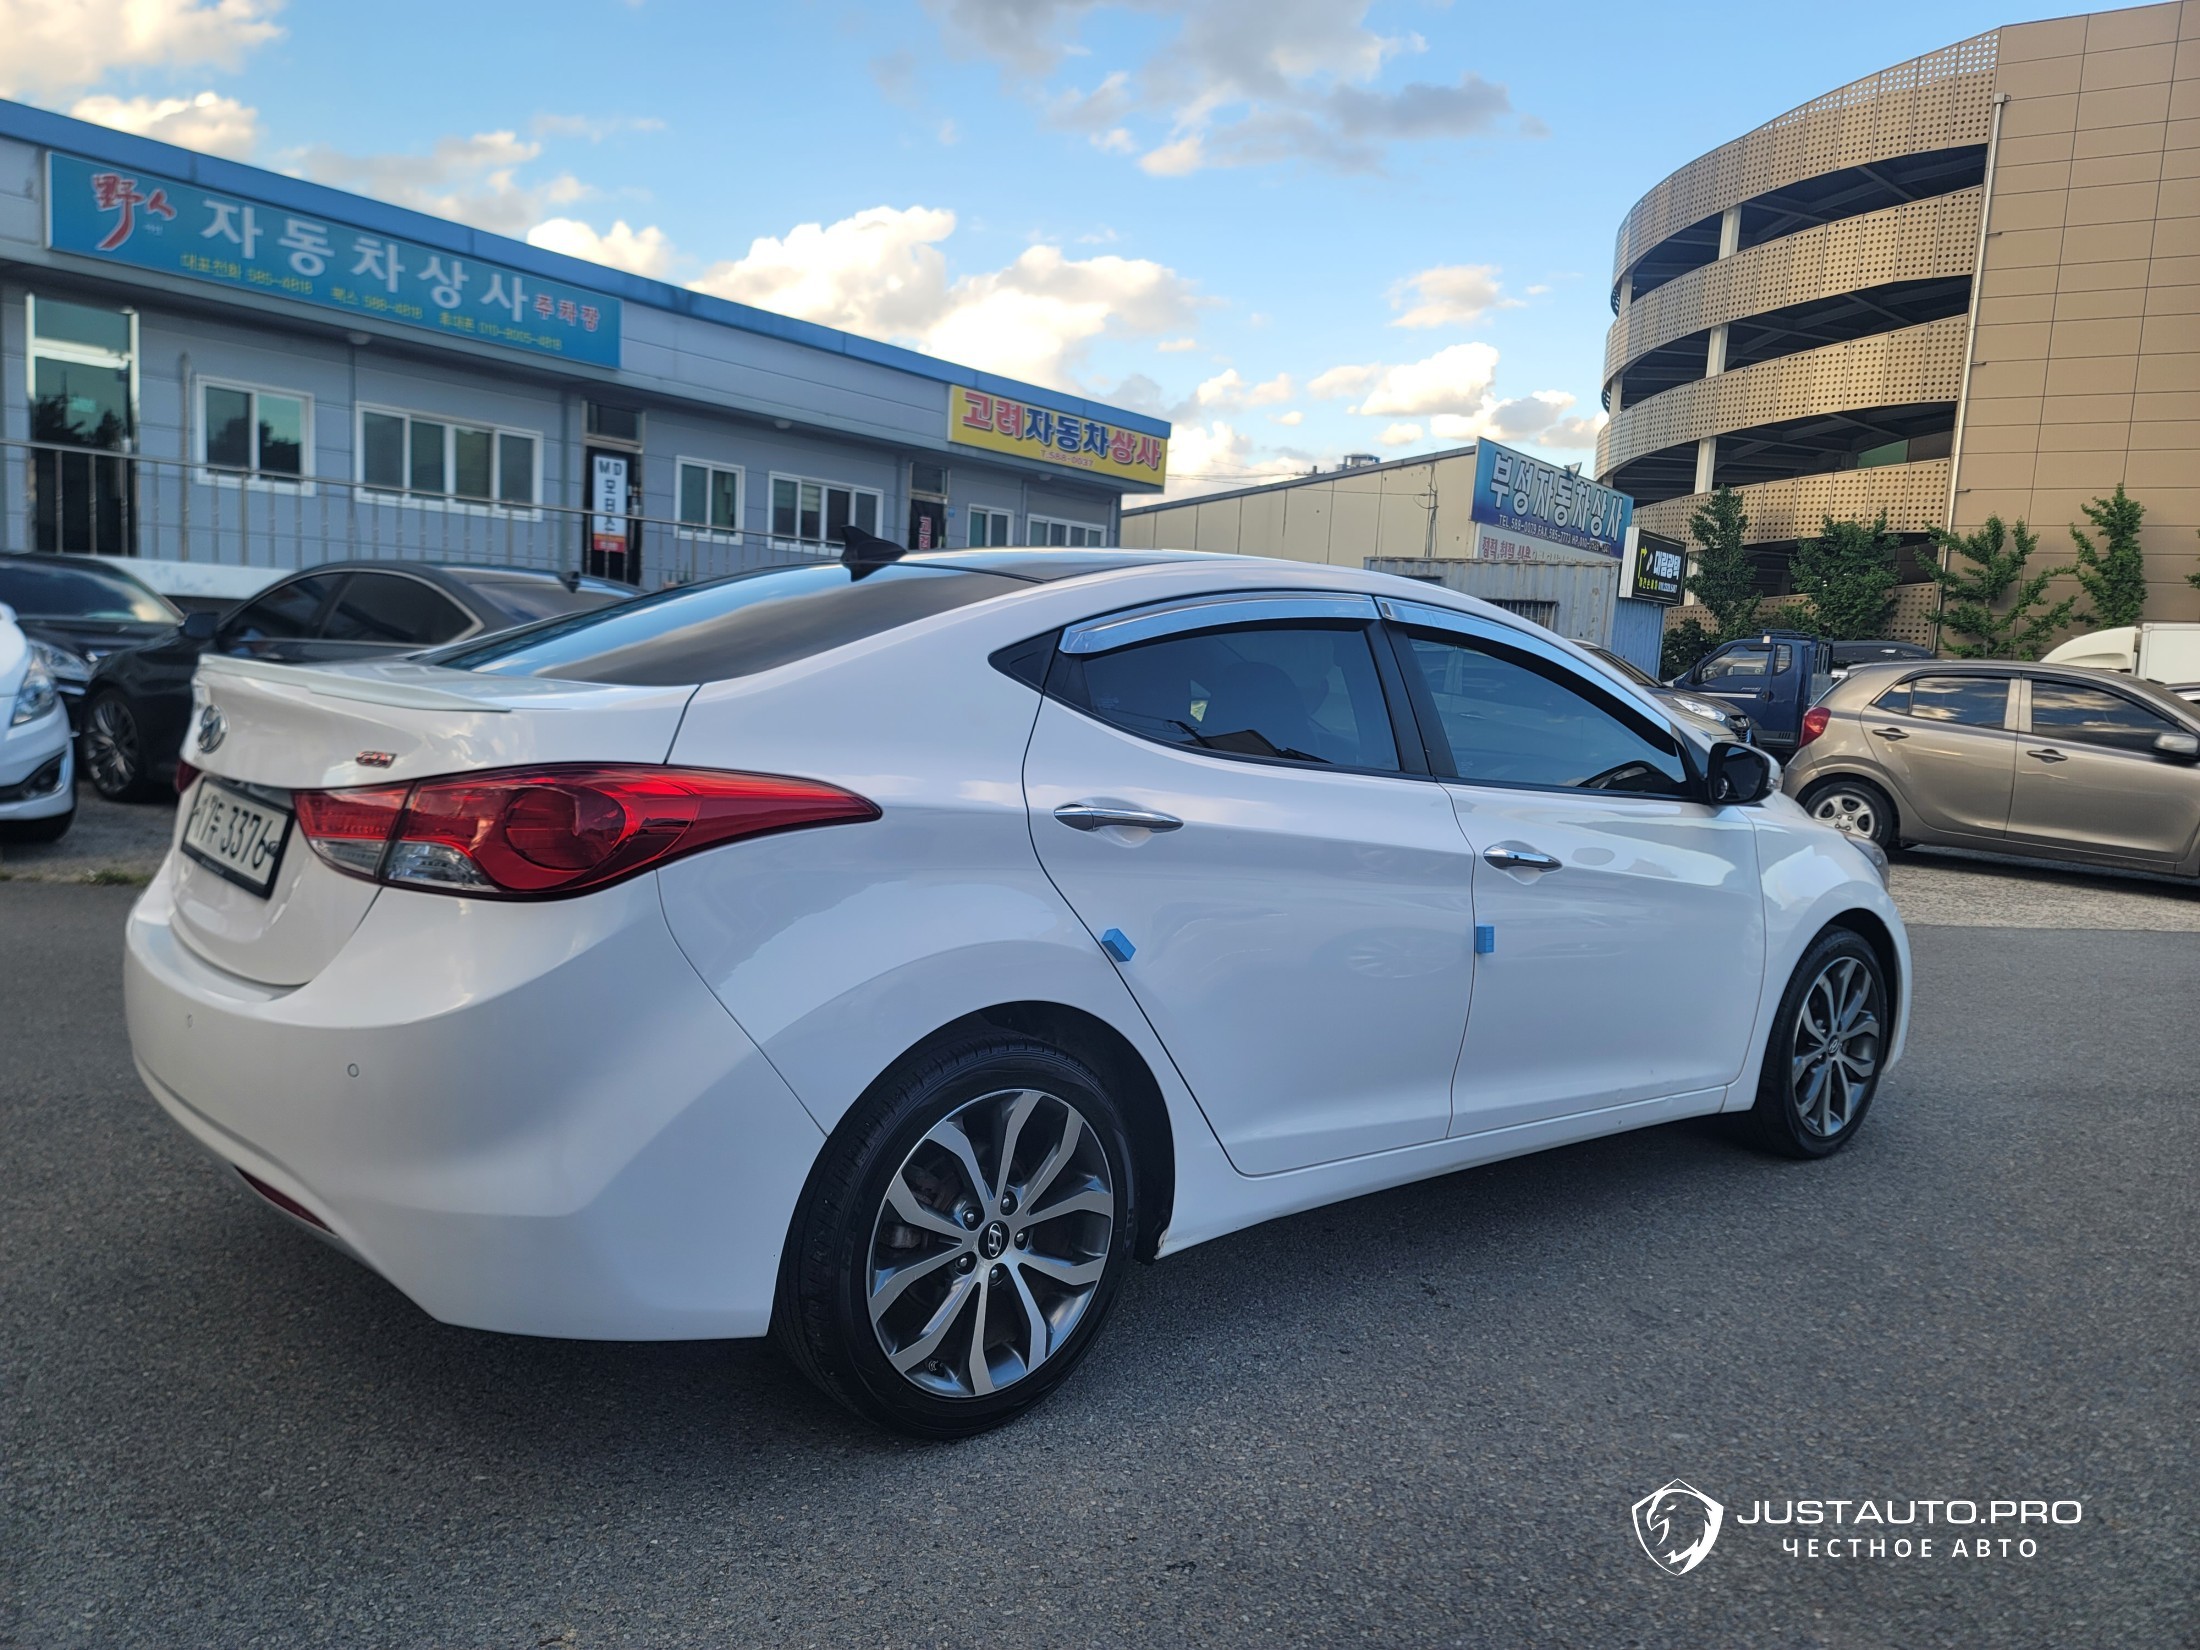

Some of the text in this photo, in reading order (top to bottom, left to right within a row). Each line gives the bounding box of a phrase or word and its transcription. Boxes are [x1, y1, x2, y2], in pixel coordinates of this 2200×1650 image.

[200, 199, 529, 323] 자동차상사
[962, 391, 1162, 470] 고려자동차상사
[1490, 453, 1624, 542] 부성자동차상사
[220, 806, 274, 871] 3376
